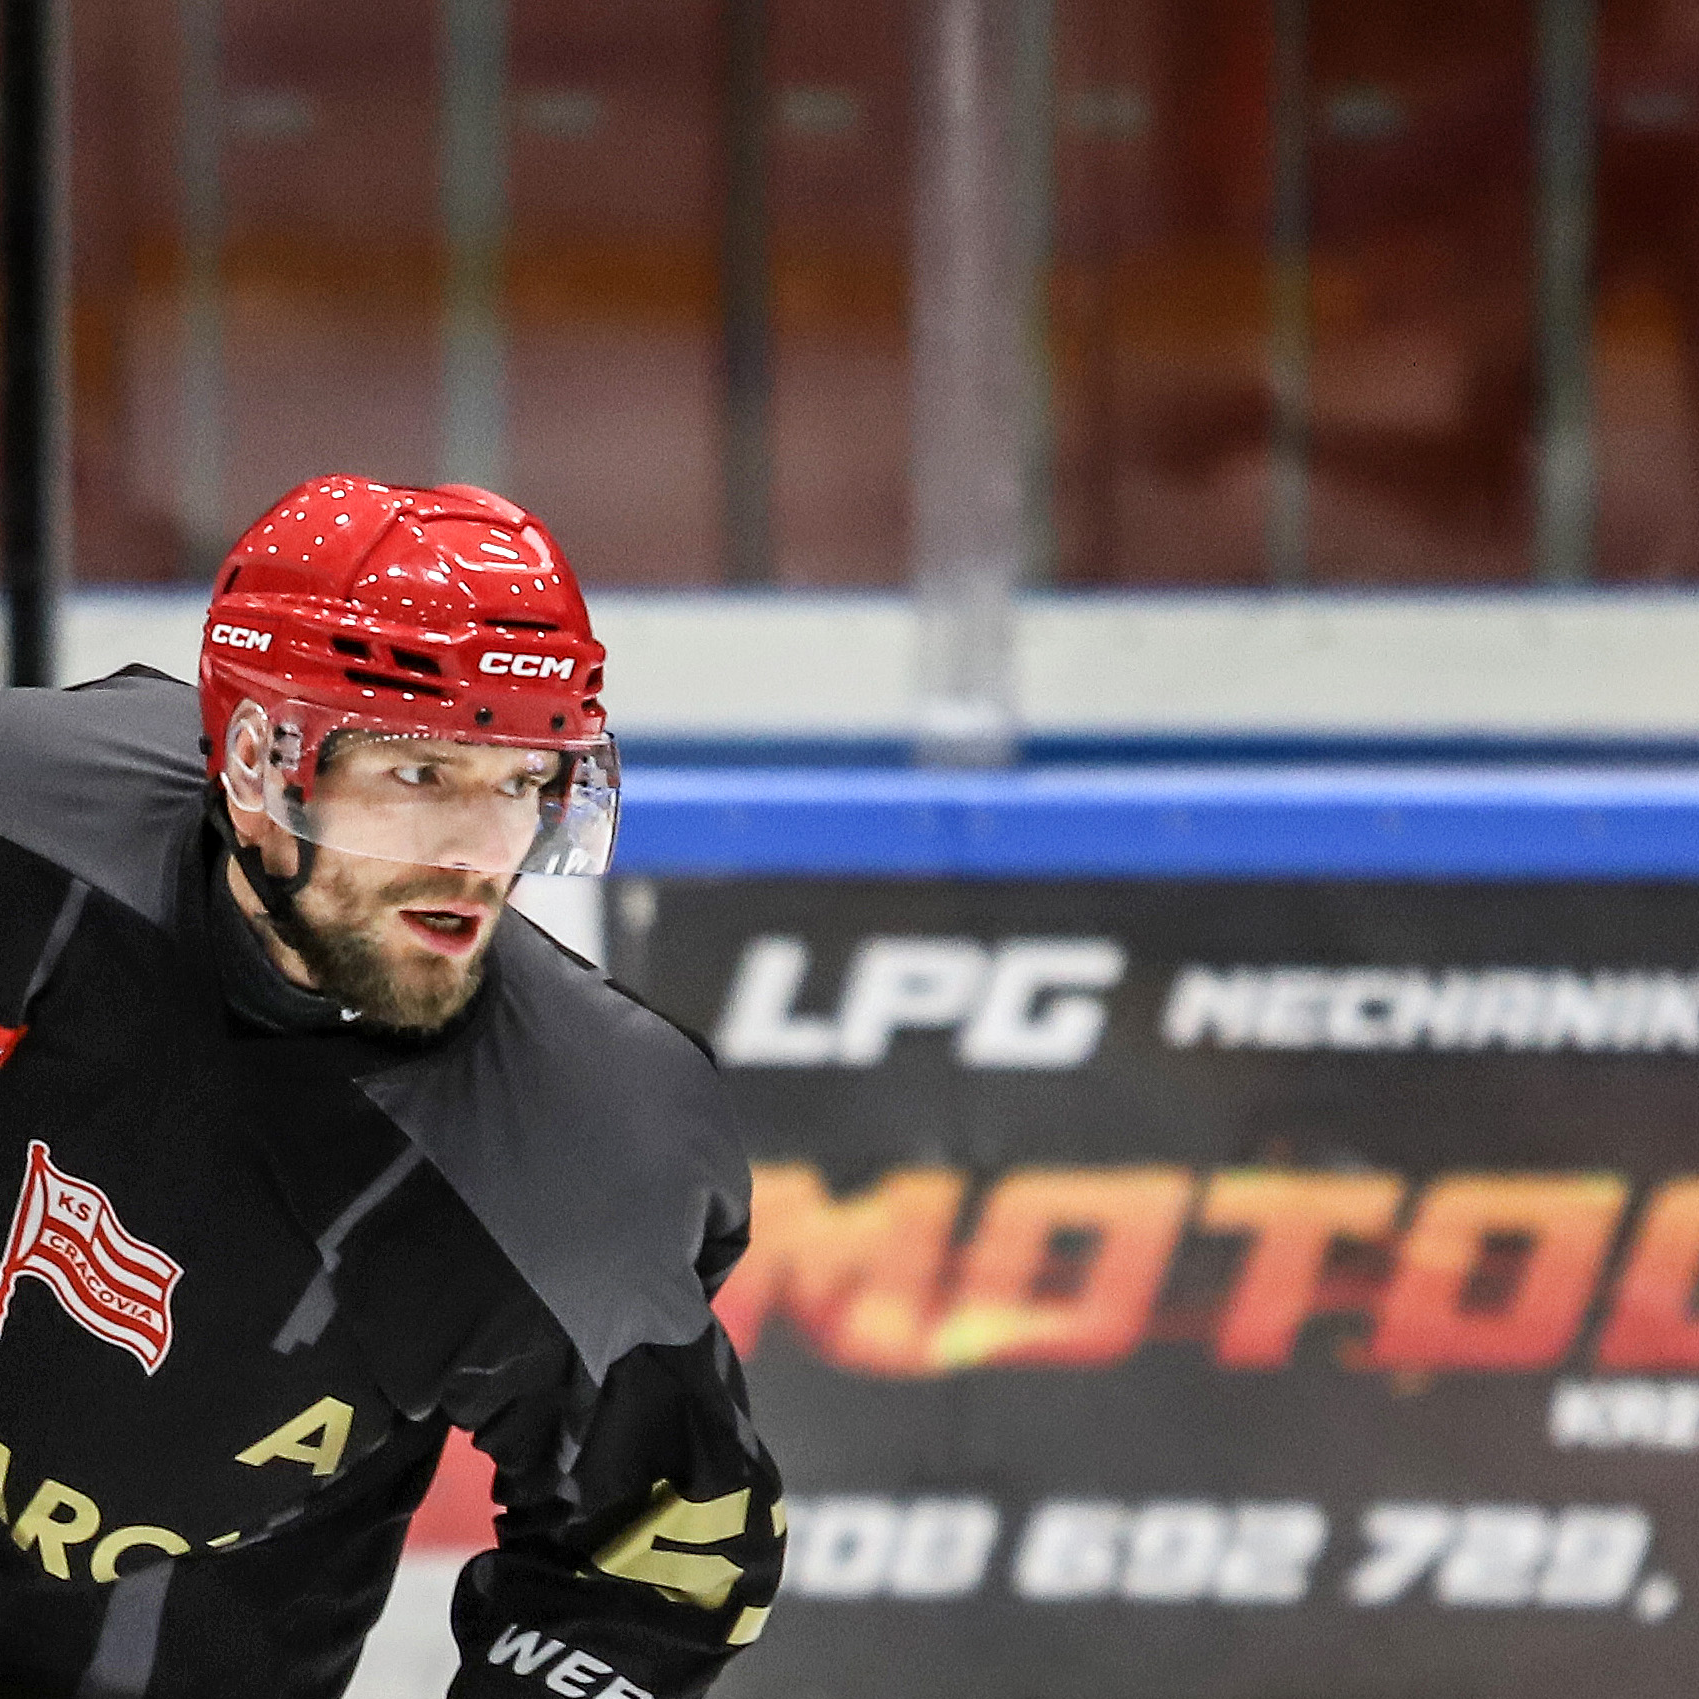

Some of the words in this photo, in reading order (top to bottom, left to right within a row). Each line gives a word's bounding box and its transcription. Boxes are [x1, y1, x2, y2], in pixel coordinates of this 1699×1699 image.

[211, 622, 272, 653] CCM
[478, 650, 576, 681] CCM
[713, 936, 1126, 1070] LPG
[57, 1191, 91, 1222] KS
[48, 1235, 155, 1322] CRACOVIA
[234, 1395, 355, 1477] A
[785, 1492, 1003, 1600] 00
